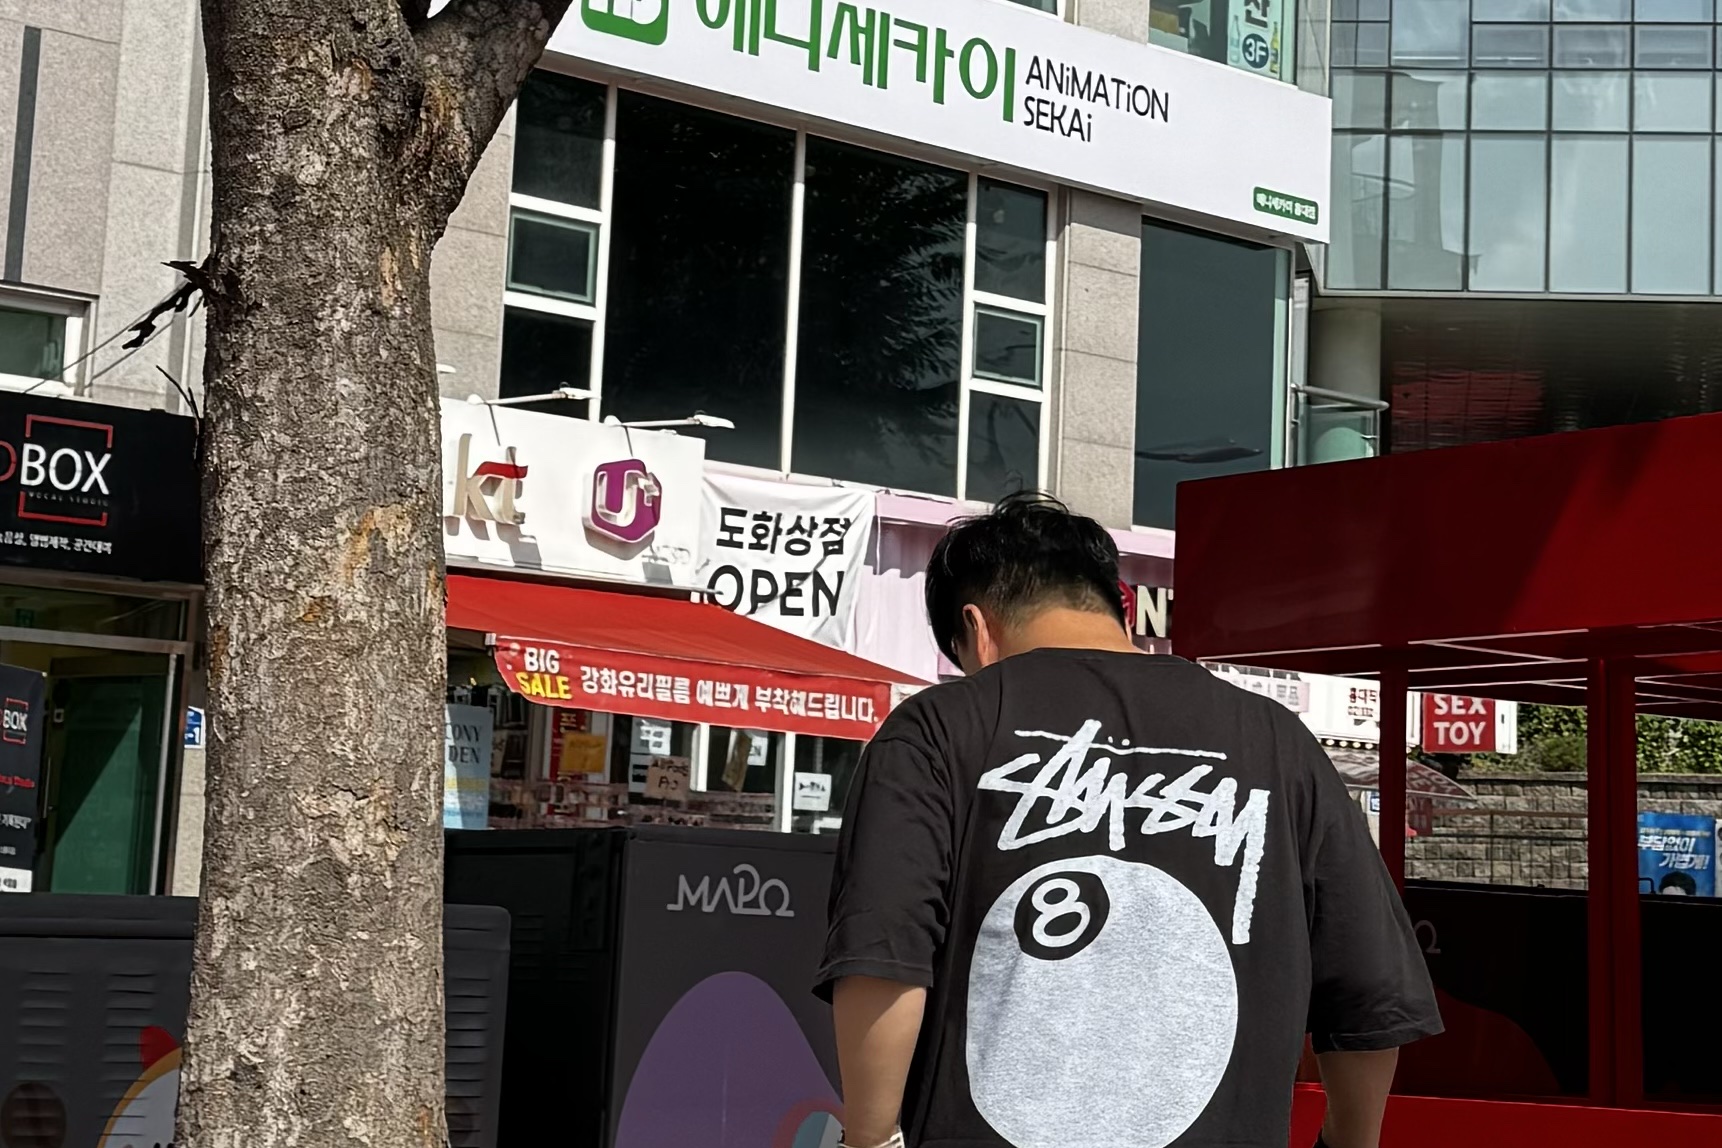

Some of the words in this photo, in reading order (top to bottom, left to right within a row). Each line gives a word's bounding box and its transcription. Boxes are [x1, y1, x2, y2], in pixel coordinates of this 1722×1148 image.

[1245, 38, 1267, 63] 3F
[453, 433, 528, 525] kt
[716, 506, 851, 557] 도화상점
[707, 564, 846, 618] OPEN
[516, 673, 573, 700] SALE
[524, 647, 560, 675] BIG
[580, 666, 691, 705] 강화유리필름
[696, 679, 750, 711] 예쁘게
[755, 686, 880, 724] 부착해드립니다.
[1433, 694, 1487, 716] SEX
[1432, 721, 1487, 746] TOY
[666, 863, 795, 917] MAPO
[1031, 878, 1091, 948] 8
